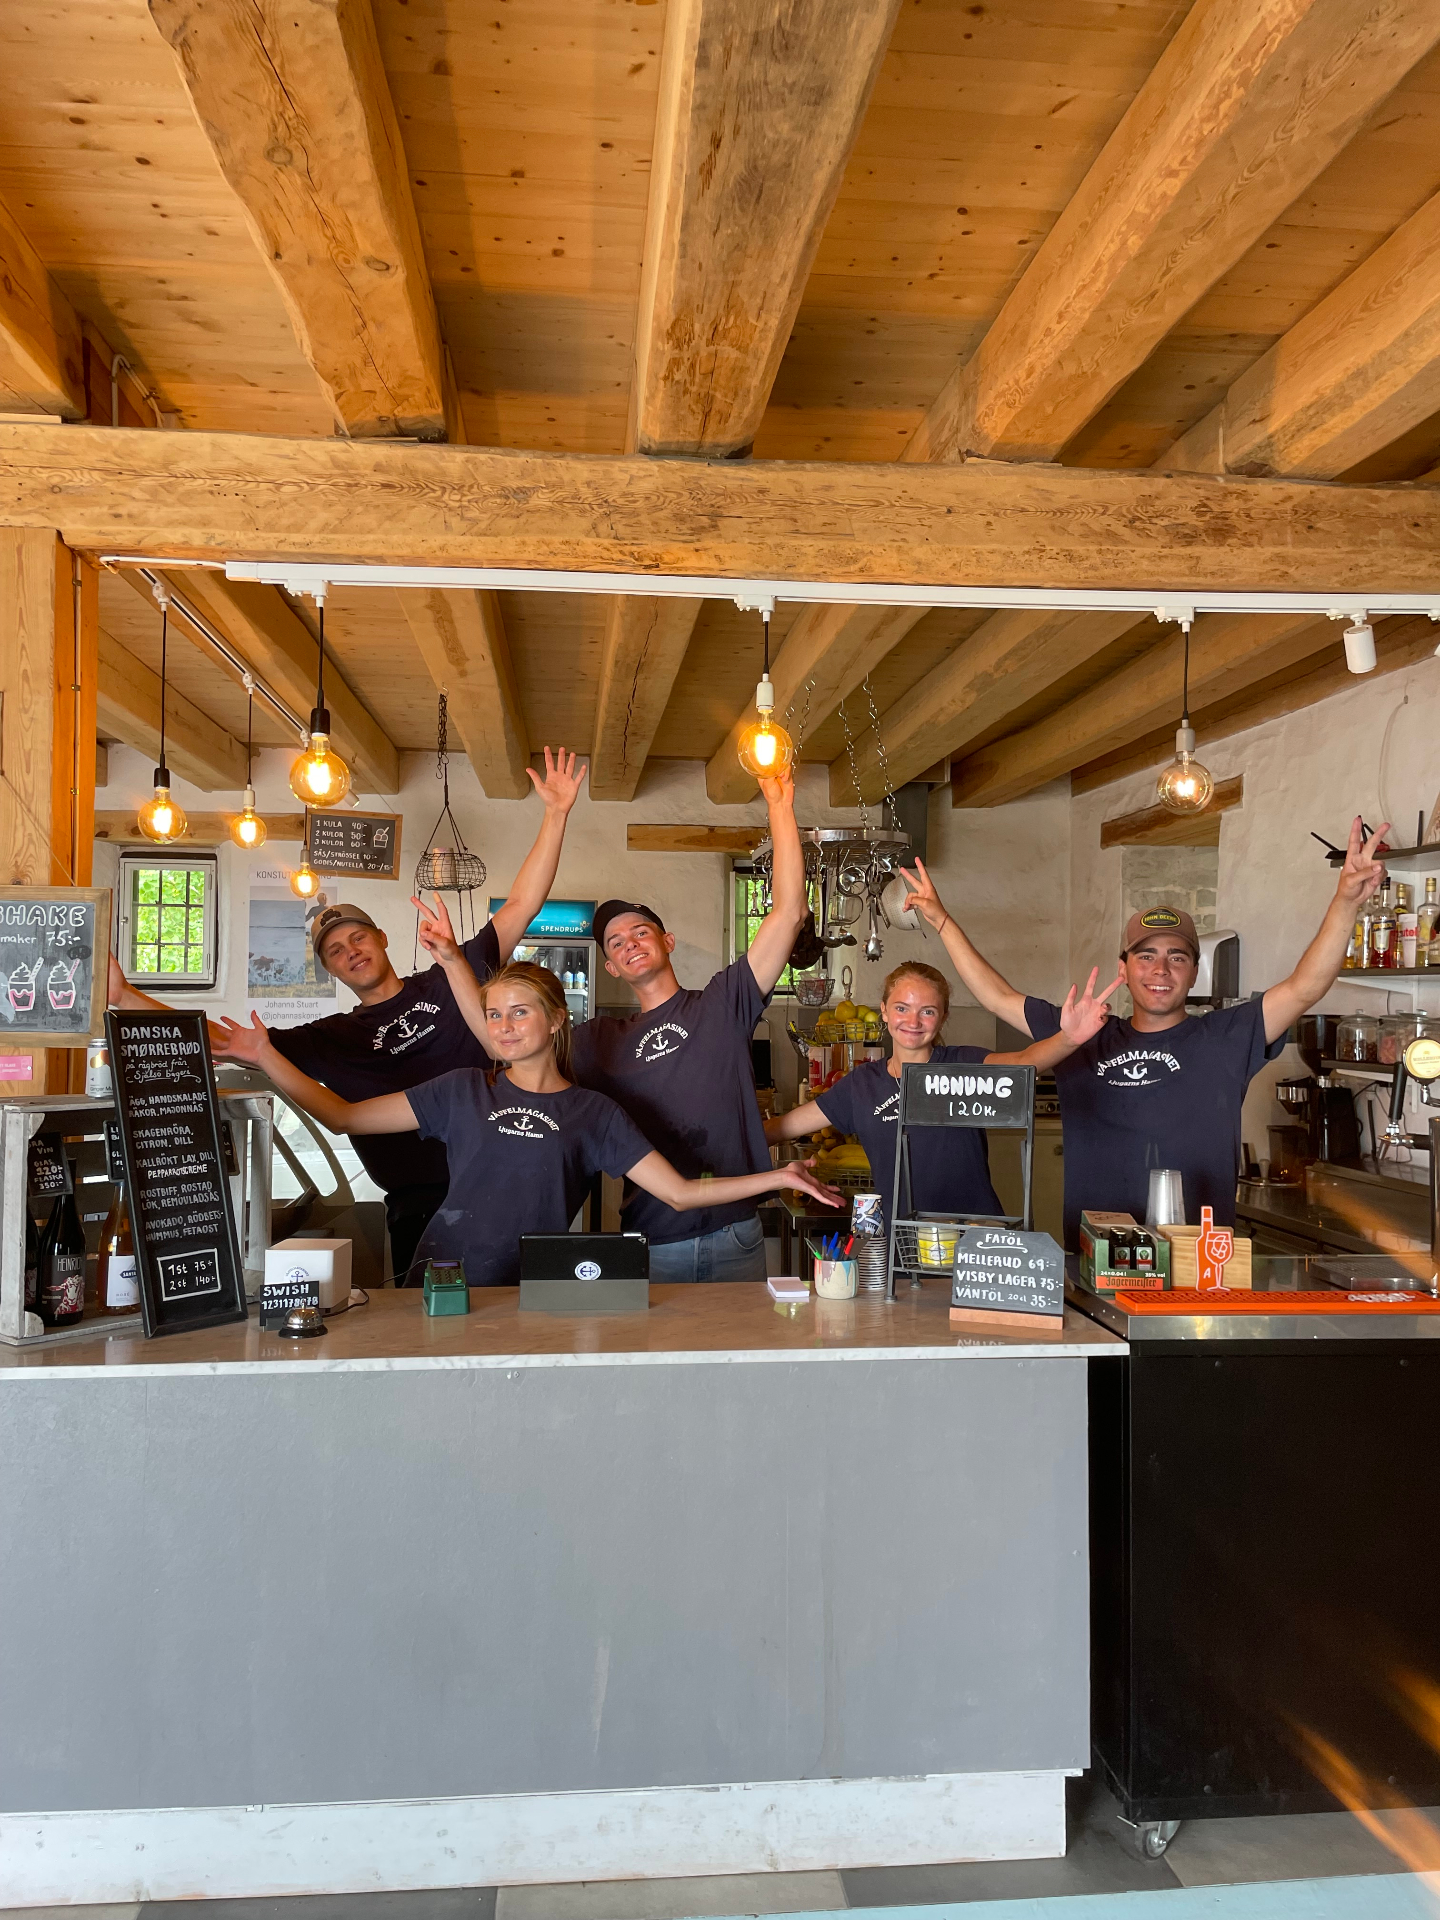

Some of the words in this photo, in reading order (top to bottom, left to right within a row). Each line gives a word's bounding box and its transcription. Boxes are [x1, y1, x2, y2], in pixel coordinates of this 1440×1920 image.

[323, 820, 342, 828] KULA
[322, 830, 344, 839] KULOR
[321, 839, 344, 847] KULOR
[540, 925, 584, 933] SPENDRUPS
[46, 930, 82, 947] 75:-
[121, 1026, 182, 1040] DANSKA
[390, 1036, 418, 1055] Ljugarns
[416, 1024, 436, 1039] Hamn
[121, 1042, 201, 1057] SMØRREBRØD
[125, 1059, 136, 1072] på
[138, 1060, 168, 1072] rågbröd
[169, 1057, 187, 1072] från
[925, 1075, 1013, 1098] HONUNG
[149, 1092, 208, 1104] HANDSKALADE
[498, 1126, 525, 1137] Ljugarns
[525, 1131, 544, 1139] Hamn
[174, 1136, 193, 1146] DILL
[36, 1147, 54, 1155] VIN
[136, 1153, 178, 1168] KALLRÖKT
[34, 1174, 64, 1182] FLASKA
[181, 1181, 213, 1193] ROSTAD
[183, 1224, 219, 1236] FETAOST
[985, 1232, 1024, 1246] FATÖL
[957, 1252, 1022, 1269] MELLERUD
[1028, 1259, 1057, 1271] 69:-
[1203, 1267, 1211, 1278] A
[956, 1269, 995, 1284] VISBY
[998, 1273, 1037, 1289] LAGER
[1040, 1278, 1064, 1291] 75:-
[263, 1284, 309, 1297] SWISH
[956, 1284, 1005, 1302] VÄNTÖL
[1030, 1294, 1058, 1308] 35:-
